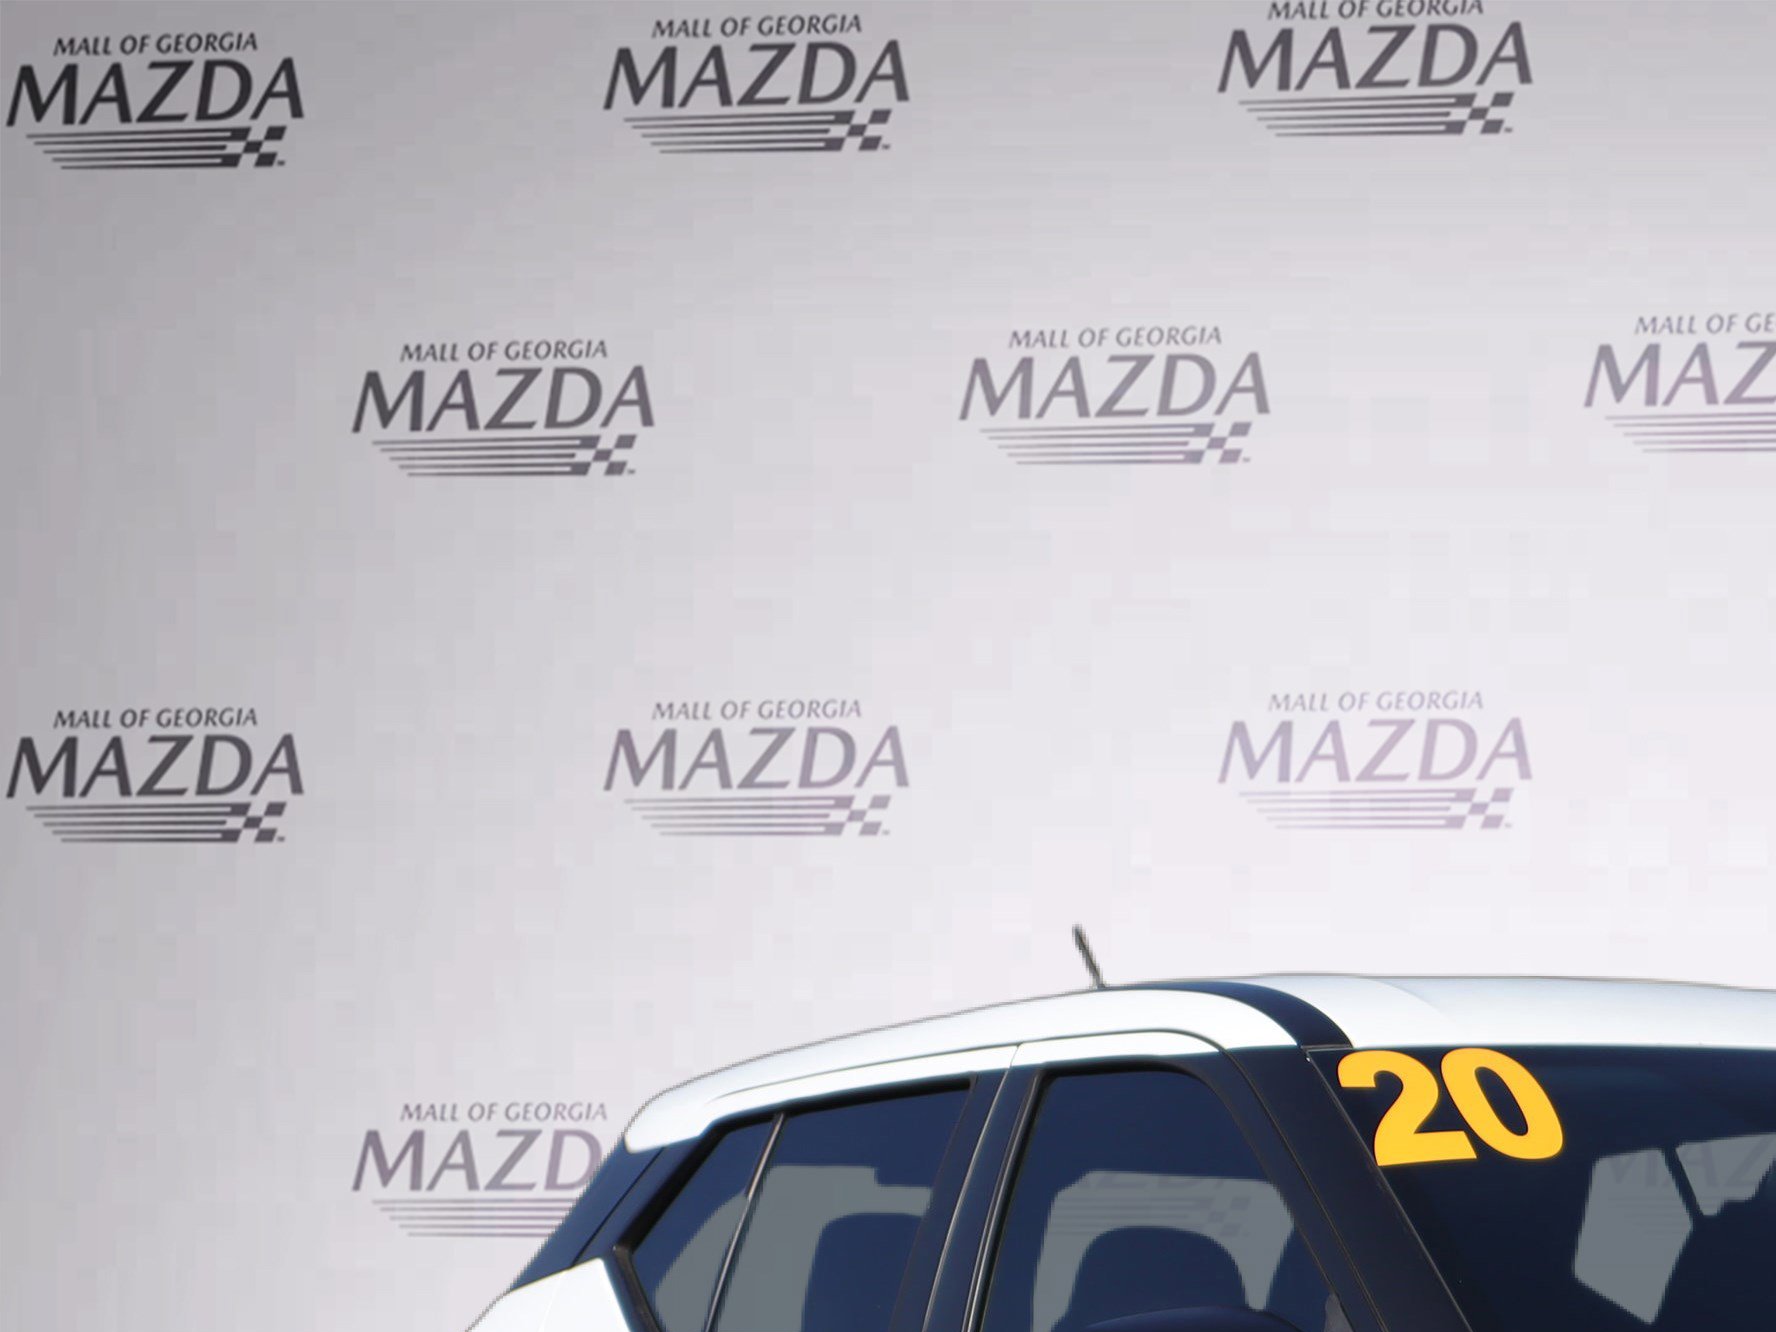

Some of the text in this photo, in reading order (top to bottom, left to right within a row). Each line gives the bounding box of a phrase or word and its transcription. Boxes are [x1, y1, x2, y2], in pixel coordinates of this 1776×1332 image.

[652, 14, 861, 38] MALL OF GEORGIA
[1268, 0, 1483, 20] MALL OF GEORGIA
[53, 32, 257, 56] MALL OF GEORGIA
[1218, 21, 1532, 93] MAZDA
[6, 57, 304, 127] MAZDA
[603, 39, 909, 110] MAZDA
[1009, 326, 1221, 348] MALL OF GEORGIA
[1635, 315, 1696, 335] MALL
[1706, 314, 1738, 334] OF
[400, 340, 607, 362] MALL OF GEORGIA
[352, 365, 654, 433] MAZDA
[959, 352, 1270, 421] MAZDA
[54, 707, 257, 729] MALL OF GEORGIA
[652, 699, 861, 720] MALL OF GEORGIA
[1268, 690, 1483, 712] MALL OF GEORGIA
[6, 733, 304, 799] MAZDA
[603, 725, 909, 791] MAZDA
[1218, 717, 1533, 784] MAZDA
[400, 1102, 607, 1122] MALL OF GEORGIA
[1337, 1048, 1564, 1167] 20
[351, 1129, 603, 1192] MAZD
